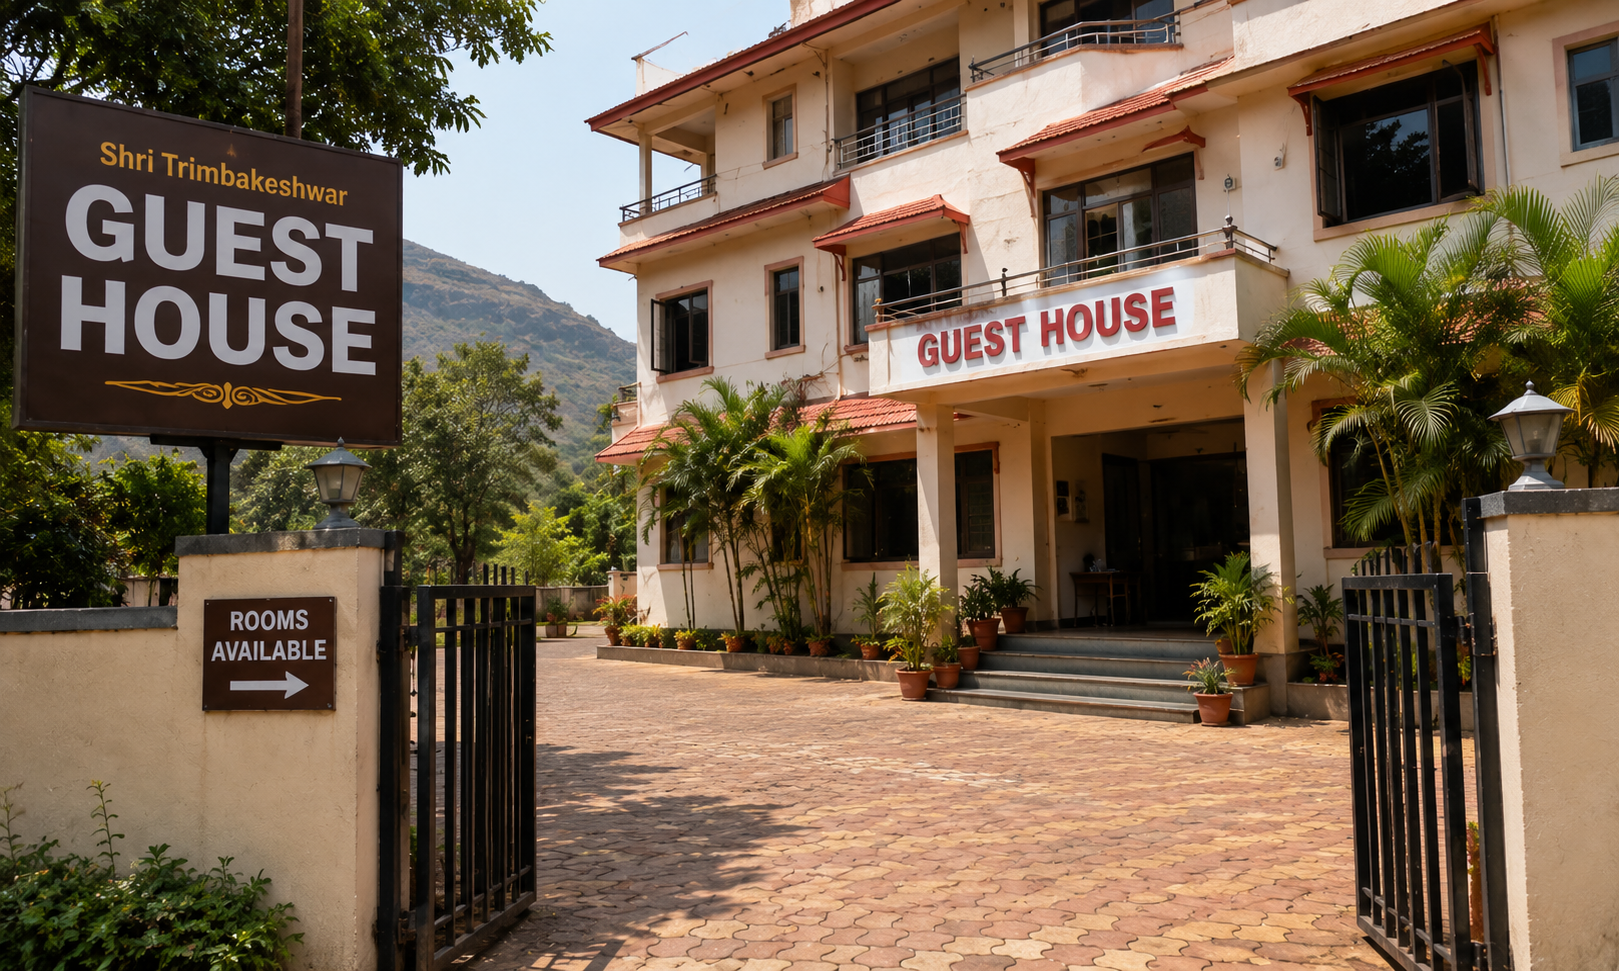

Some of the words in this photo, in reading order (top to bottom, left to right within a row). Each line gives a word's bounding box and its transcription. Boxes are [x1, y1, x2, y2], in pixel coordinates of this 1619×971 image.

[100, 141, 154, 173] Shri
[161, 152, 348, 206] Trimbakeshwar
[65, 184, 374, 292] GUEST
[60, 275, 377, 376] HOUSE
[917, 315, 1027, 368] GUEST
[1040, 286, 1176, 348] HOUSE
[210, 639, 327, 662] AVAILABLE
[229, 609, 309, 631] ROOMS
